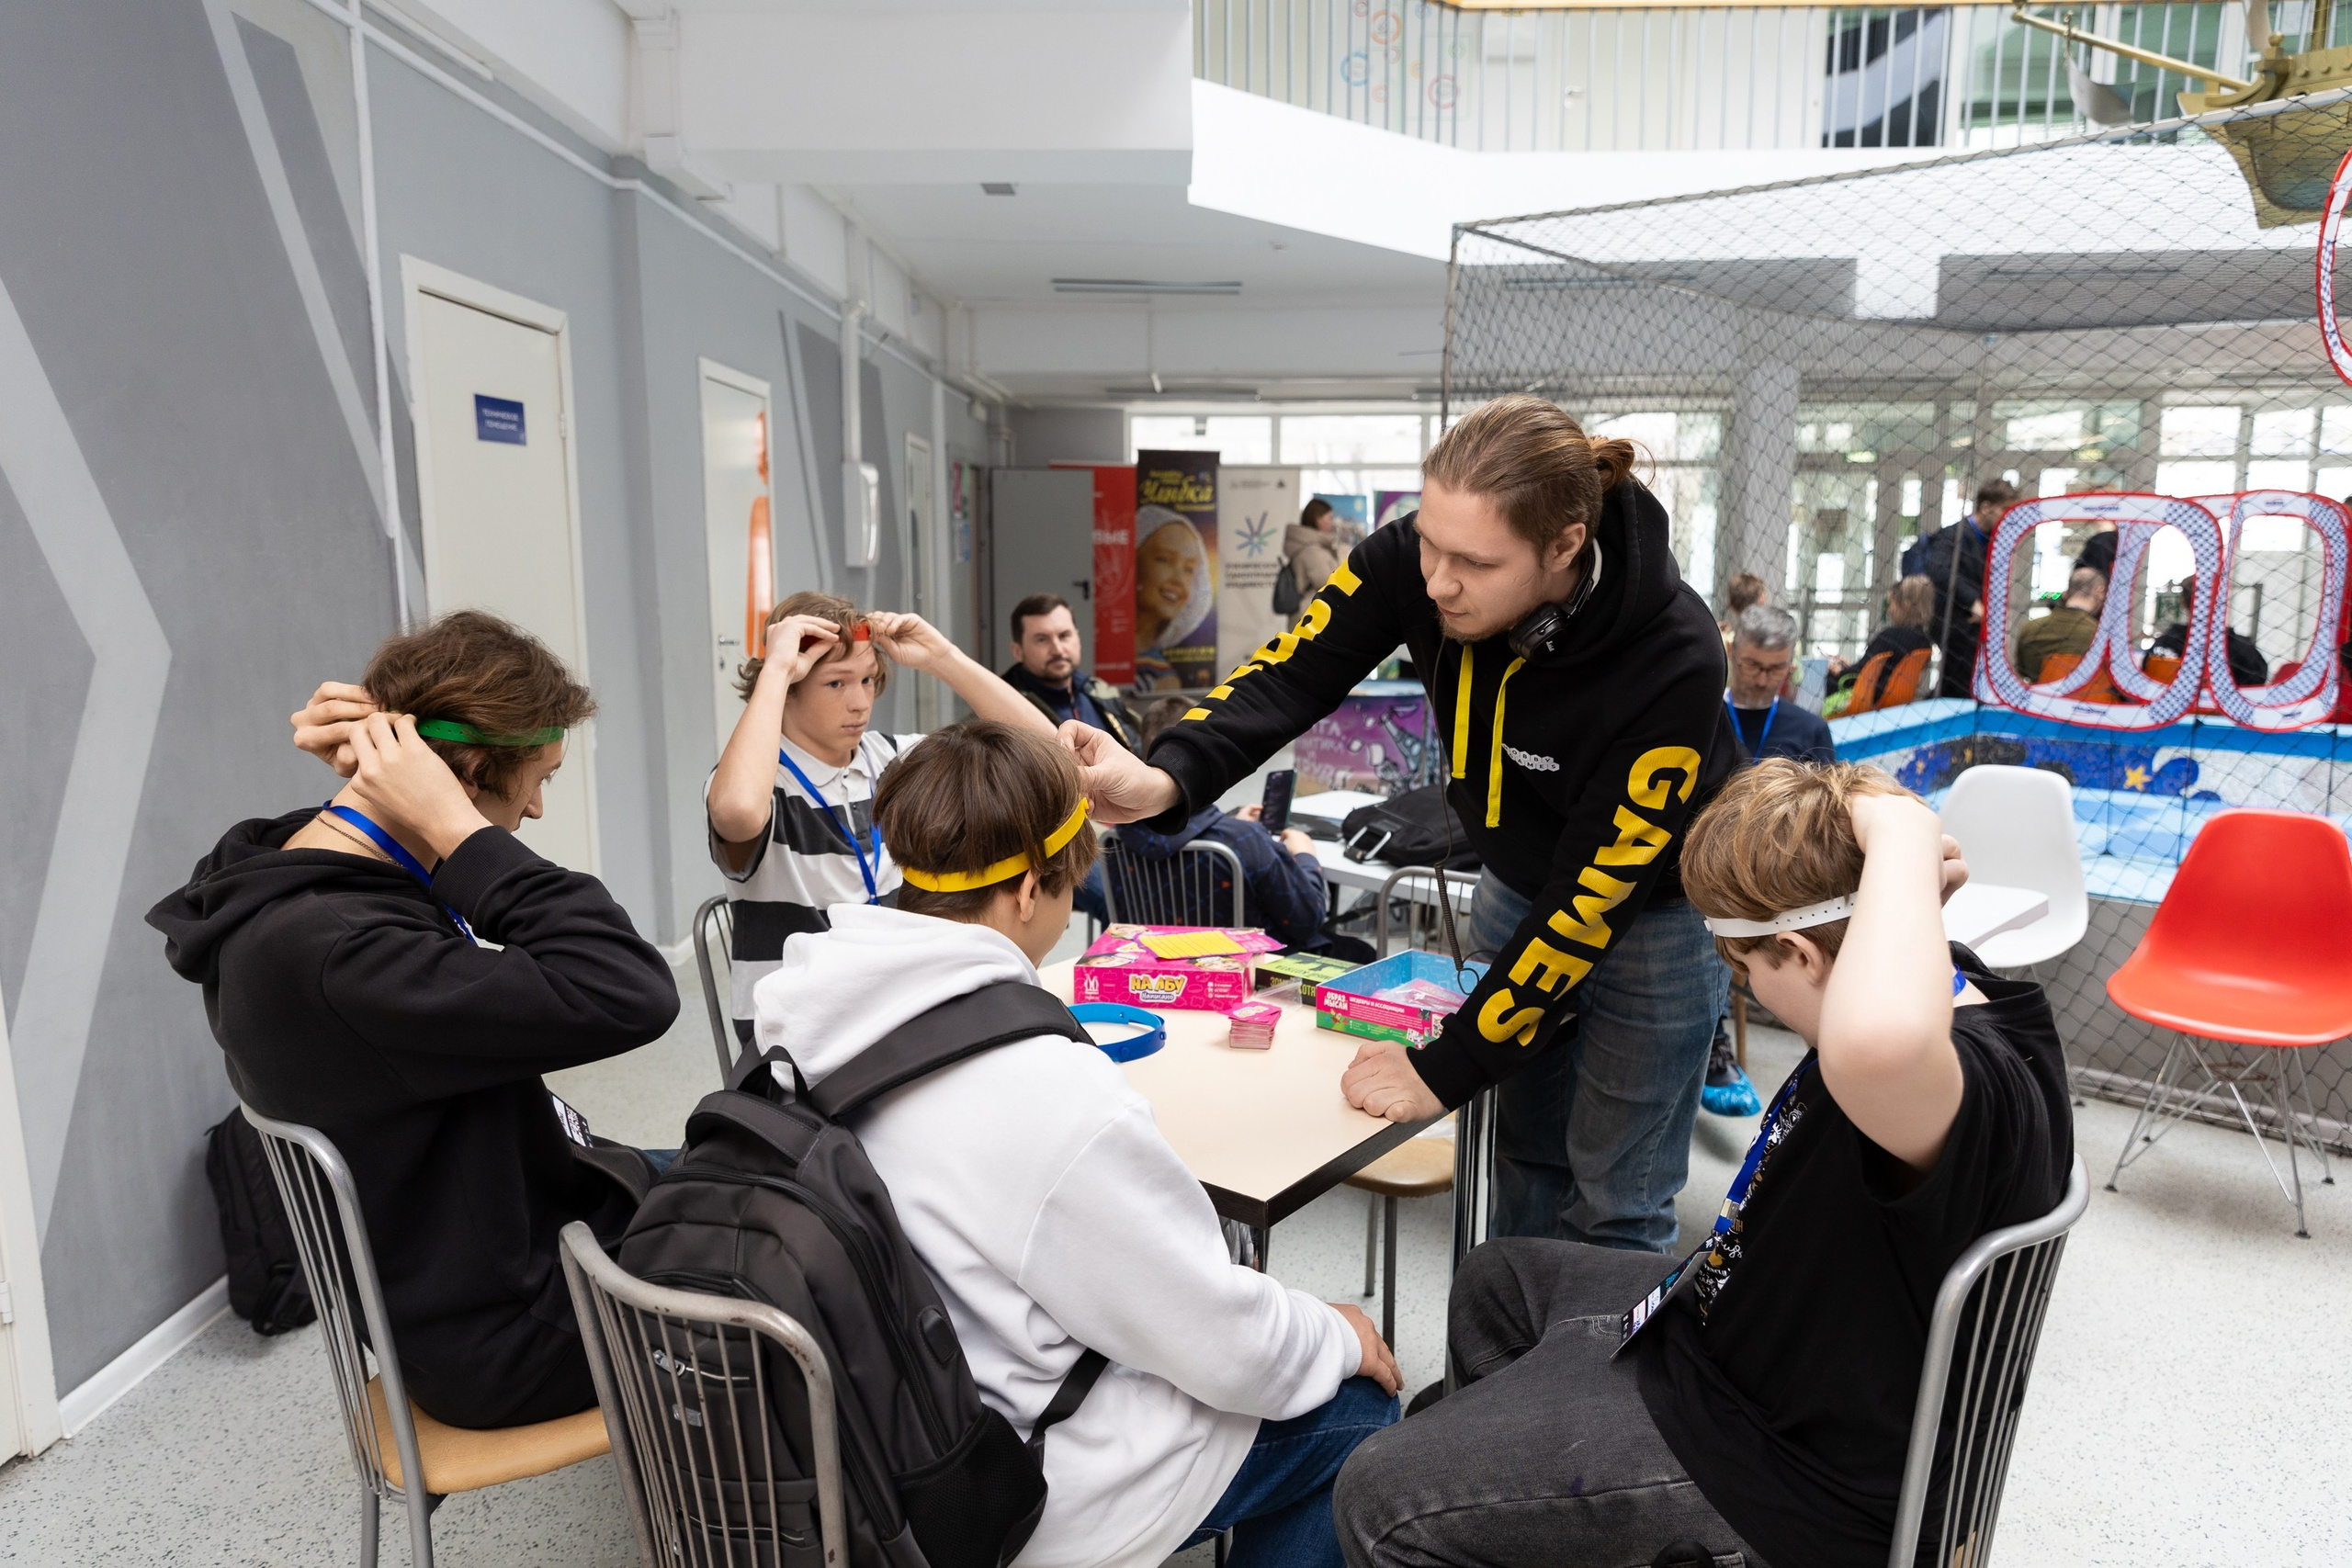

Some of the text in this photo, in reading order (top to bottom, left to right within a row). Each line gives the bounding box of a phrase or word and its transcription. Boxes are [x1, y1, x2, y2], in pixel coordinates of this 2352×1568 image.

[1502, 743, 1552, 763] HOBBY
[1508, 752, 1557, 770] GAMES
[1477, 746, 1701, 1047] GAMES
[1131, 975, 1185, 994] НА ЛБУ
[1142, 992, 1175, 1001] Написано
[1324, 998, 1349, 1011] МЫСЛИ
